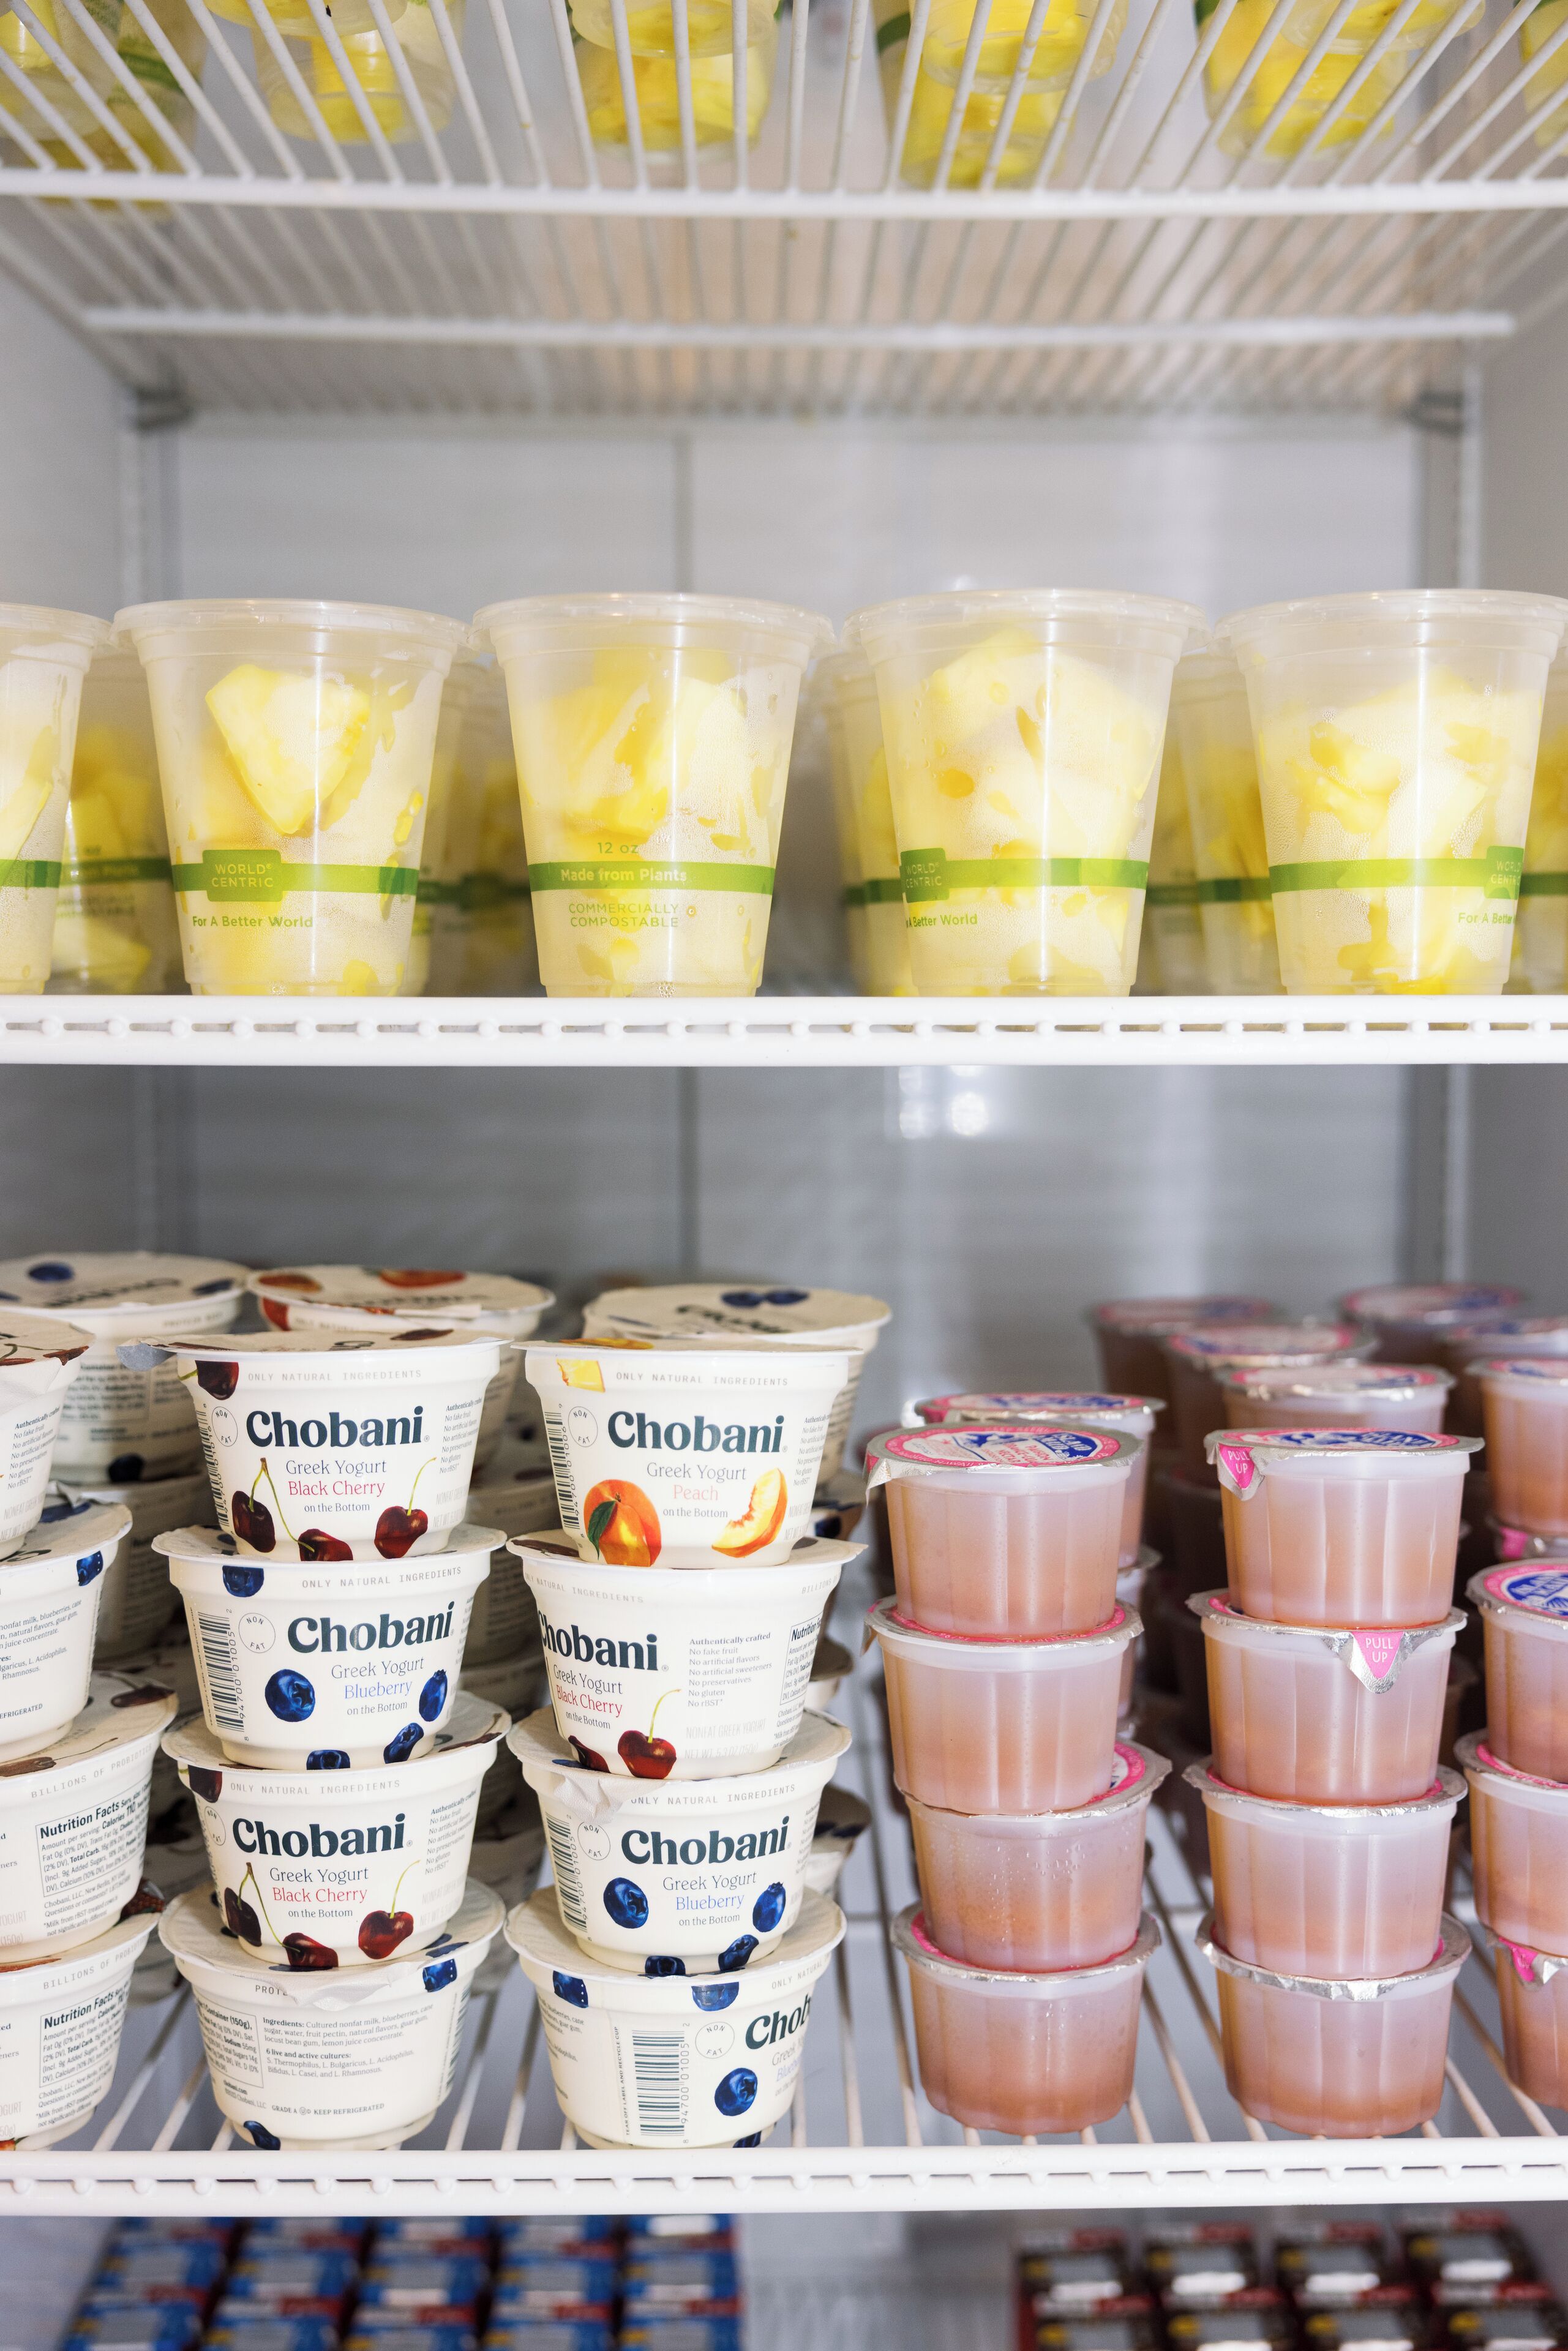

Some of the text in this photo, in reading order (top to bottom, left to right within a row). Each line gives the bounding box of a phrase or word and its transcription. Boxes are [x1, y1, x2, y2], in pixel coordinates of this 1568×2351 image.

[598, 842, 639, 853] 12 oz
[561, 868, 687, 883] Made from Plants
[1491, 875, 1520, 885] CENTRC
[212, 877, 274, 888] CENTRIC
[906, 876, 942, 888] CENTRIC
[569, 903, 679, 915] COMMERCIALLY
[192, 916, 312, 928] For A Better World
[571, 916, 678, 928] COMPOSTABLE
[913, 916, 936, 927] Better
[940, 912, 977, 925] World
[1458, 912, 1512, 924] For A Better
[282, 1373, 332, 1381] NATURAL
[343, 1370, 421, 1380] INGREDIENTS
[652, 1374, 702, 1383] NATURAL
[714, 1376, 787, 1385] INGREDIENTS
[215, 1409, 228, 1419] NON
[573, 1409, 588, 1419] NON
[221, 1435, 232, 1444] FAT
[577, 1436, 590, 1444] FAT
[1228, 1450, 1249, 1461] PULL
[287, 1460, 387, 1475] Greek Yogurt
[647, 1463, 746, 1482] Greek Yogurt
[1236, 1463, 1248, 1473] UP
[288, 1480, 384, 1498] Black Cherry
[673, 1484, 718, 1501] Peach
[319, 1503, 332, 1512] the
[336, 1502, 370, 1511] Bottom
[677, 1507, 691, 1517] the
[694, 1509, 727, 1518] Bottom
[302, 1567, 461, 1588] ONLY NATURAL INGREDIENTS
[536, 1578, 643, 1603] NATURAL INGREDIENTS
[246, 1616, 264, 1625] NON
[690, 1632, 770, 1644] Authentically crafted
[1365, 1637, 1394, 1649] PULL
[250, 1641, 265, 1651] FAT
[1372, 1651, 1387, 1663] UP
[332, 1657, 424, 1679] Greek Yogurt
[736, 1663, 771, 1673] sweeteners
[553, 1664, 622, 1694] Greek Yogurt
[702, 1678, 751, 1687] preservatives
[345, 1681, 412, 1699] Blueberry
[556, 1685, 622, 1717] Black Cherry
[361, 1705, 375, 1714] the
[377, 1702, 408, 1713] Bottom
[566, 1711, 611, 1729] on the Bottom
[686, 1725, 715, 1739] NONFAT
[718, 1723, 741, 1738] GREEK
[31, 1775, 87, 1798] BILLIONS
[94, 1768, 104, 1777] OF
[230, 1783, 253, 1791] ONLY
[321, 1780, 400, 1794] INGREDIENTS
[668, 1795, 718, 1805] NATURAL
[727, 1784, 795, 1802] INGREDIENTS
[40, 1802, 119, 1839] Nutrition Facts
[207, 1810, 217, 1820] NON
[583, 1824, 599, 1834] NON
[212, 1834, 221, 1842] FAT
[588, 1848, 602, 1858] FAT
[270, 1867, 369, 1884] Greek Yogurt
[663, 1871, 757, 1891] Greek Yogurt
[272, 1888, 367, 1903] Black Cherry
[676, 1895, 745, 1910] Blueberry
[318, 1909, 353, 1918] Bottom
[692, 1917, 707, 1925] the
[709, 1915, 740, 1925] Bottom
[43, 1959, 109, 1989] BILLIONS OF
[772, 1961, 823, 1990] ONLY NATURAL
[44, 1991, 114, 2029] Nutrition Facts
[263, 2017, 304, 2028] Ingredients:
[340, 2019, 362, 2028] nonfat
[383, 2009, 419, 2023] blueberries,
[421, 2004, 433, 2013] cane
[706, 2025, 726, 2033] NON
[706, 2047, 722, 2056] FAT
[681, 2044, 689, 2080] 01005
[333, 2104, 384, 2115] REFRIGERATED
[681, 2087, 689, 2124] 94700
